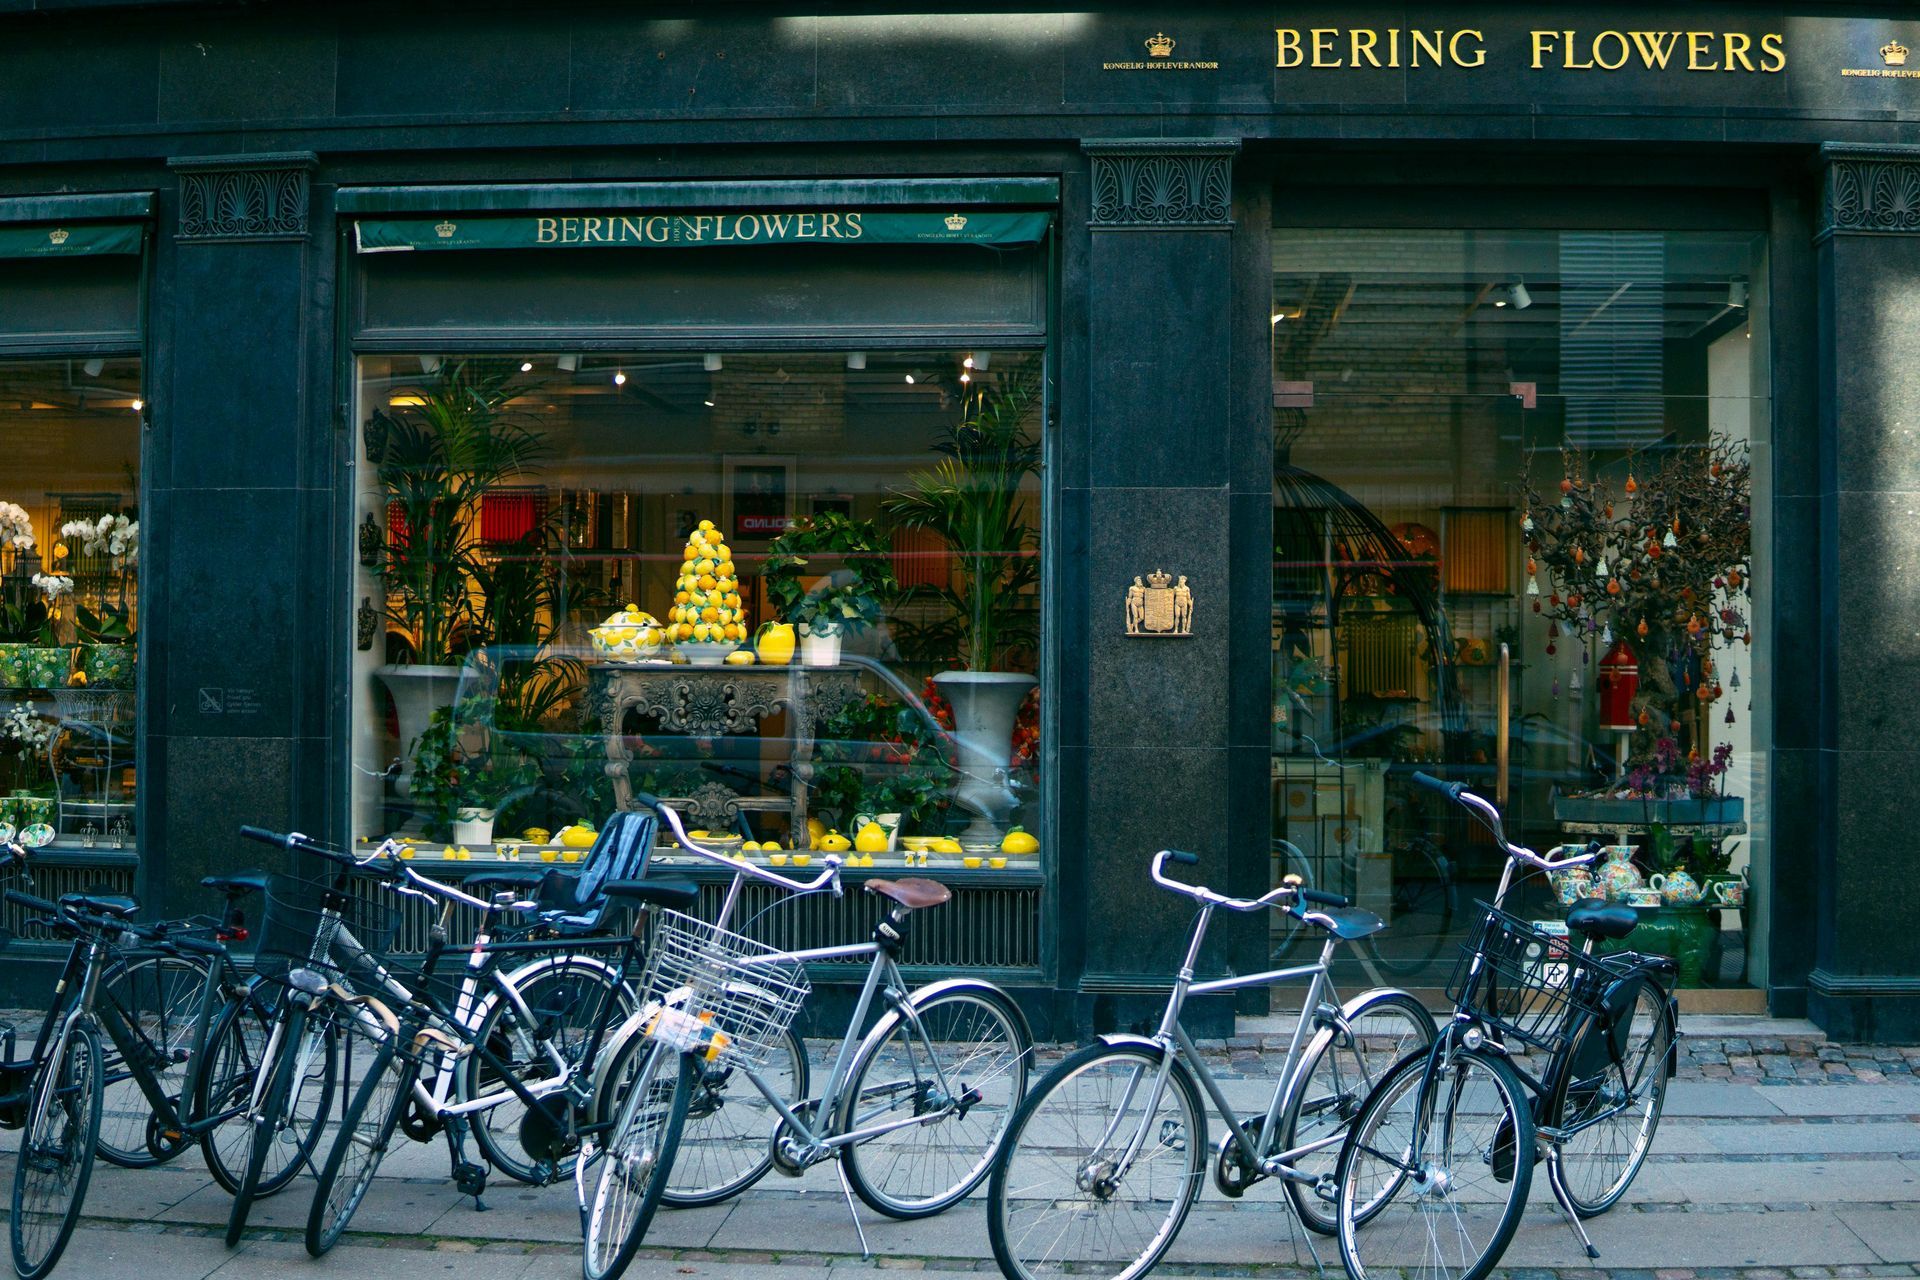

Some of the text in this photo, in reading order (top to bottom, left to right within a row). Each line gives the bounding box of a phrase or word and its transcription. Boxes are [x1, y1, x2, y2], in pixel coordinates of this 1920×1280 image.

[1275, 28, 1787, 73] BERING FLOWERS
[1103, 61, 1219, 70] KONGELIG HOFLEVERANDØR
[1841, 69, 1881, 78] KONGELIG
[535, 216, 671, 243] BERING
[681, 213, 863, 242] FLOWERS
